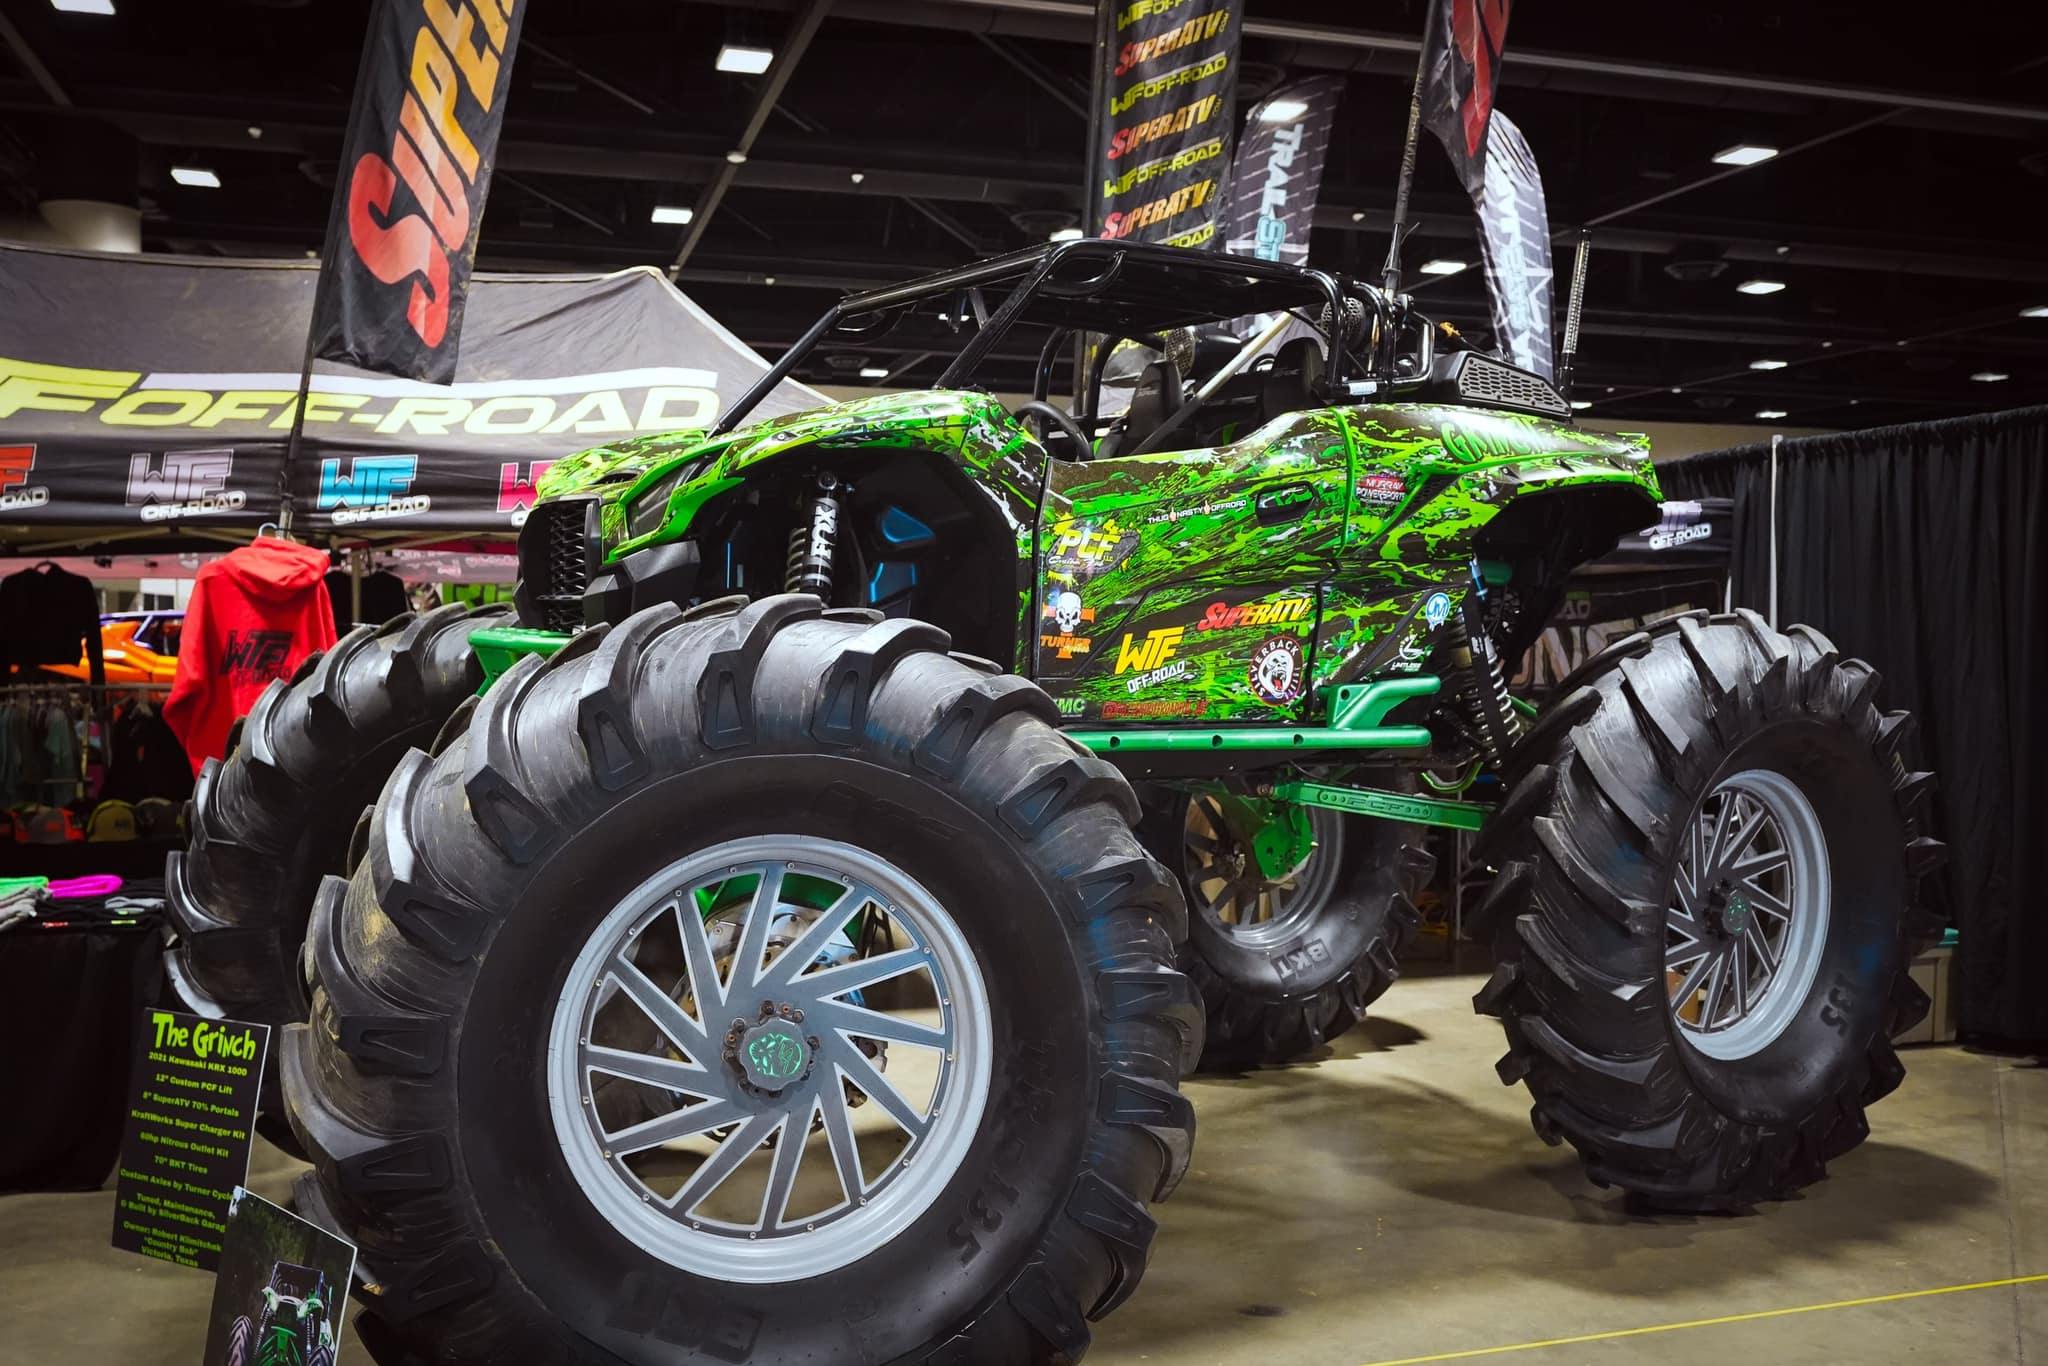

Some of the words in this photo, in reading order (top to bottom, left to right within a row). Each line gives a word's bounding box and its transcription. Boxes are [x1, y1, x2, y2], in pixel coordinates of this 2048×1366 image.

[1114, 9, 1225, 77] SUPERATV
[1144, 56, 1228, 98] OFF-ROAD
[1108, 94, 1217, 160] SUPERATV
[349, 0, 514, 348] SUPE
[1137, 142, 1222, 183] OFF-ROAD
[1101, 179, 1212, 240] SUPERATV
[100, 386, 720, 435] OFF-ROAD
[126, 449, 234, 506] WTF
[317, 454, 419, 509] WTF
[141, 491, 246, 521] OFF-ROAD
[331, 495, 431, 524] OFF-ROAD
[811, 505, 836, 559] FOX
[1056, 529, 1121, 561] PCF
[1649, 522, 1712, 551] OFF-ROAD
[1196, 597, 1311, 631] SUPERATV
[222, 631, 294, 673] WTF
[1114, 626, 1185, 675] WTF
[1251, 639, 1299, 696] SILVERBACK
[1127, 660, 1186, 693] OFF-ROAD
[1276, 942, 1325, 979] BKT
[152, 1012, 189, 1048] The
[192, 1022, 257, 1061] Grinch
[148, 1051, 167, 1063] 2021
[168, 1055, 207, 1069] Kawasaki
[208, 1061, 226, 1073] KRX
[227, 1065, 248, 1077] 1000
[170, 1076, 200, 1089] Custom
[201, 1081, 217, 1092] PCF
[218, 1084, 233, 1095] Lift
[153, 1094, 190, 1108] SuperATV
[210, 1104, 240, 1118] Portals
[160, 1135, 190, 1149] Nitrous
[190, 1140, 215, 1155] Outlet
[216, 1148, 230, 1159] Kit
[175, 1118, 198, 1130] Super
[199, 1123, 231, 1137] Charger
[232, 1128, 246, 1140] Kit
[120, 1168, 149, 1182] Custom
[173, 1179, 183, 1191] by
[184, 1183, 211, 1196] Turner
[212, 1188, 234, 1201] Cycle
[169, 1159, 186, 1170] BKT
[187, 1163, 208, 1175] Tires
[201, 1218, 226, 1233] Garag
